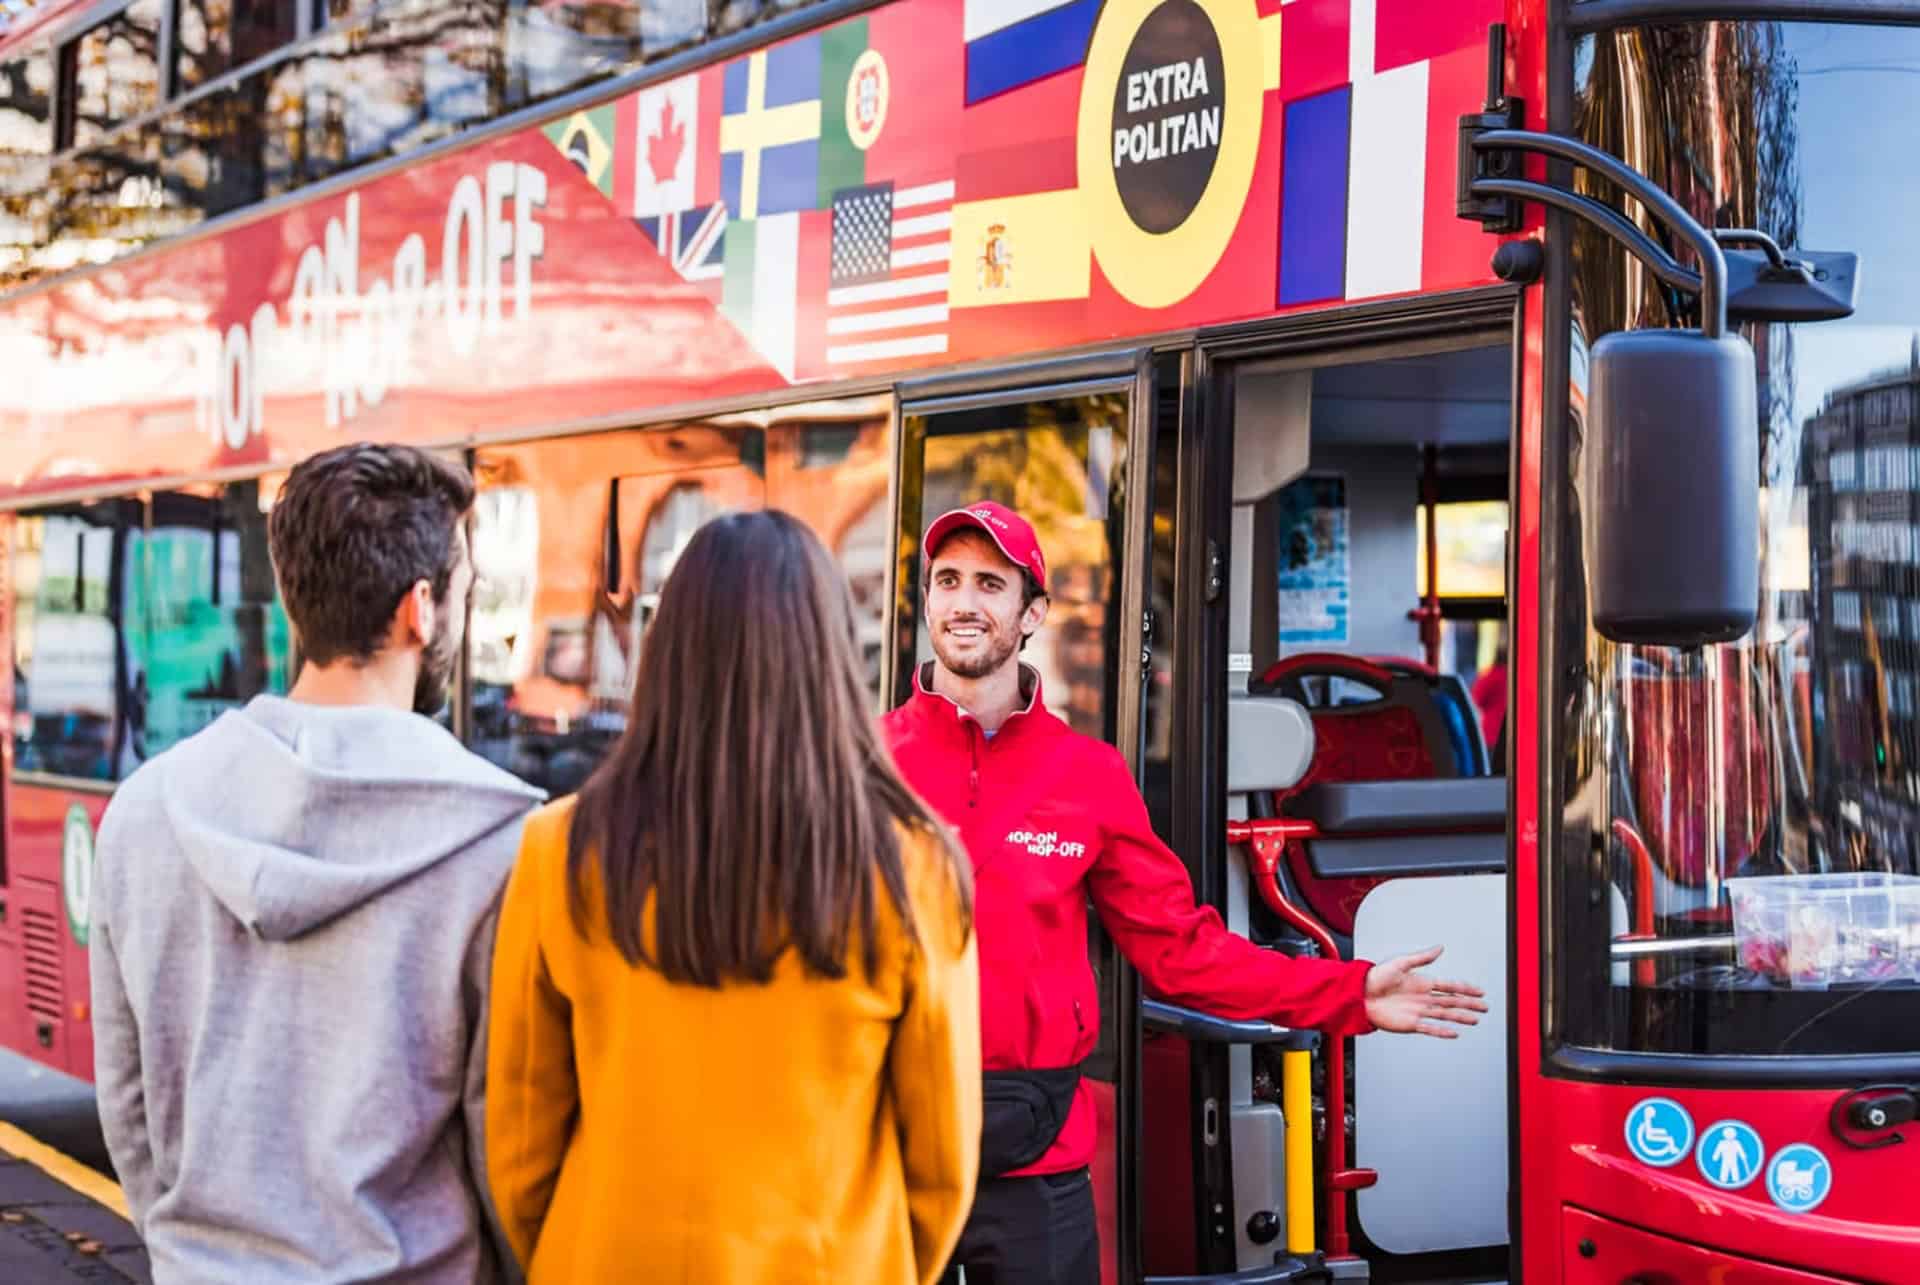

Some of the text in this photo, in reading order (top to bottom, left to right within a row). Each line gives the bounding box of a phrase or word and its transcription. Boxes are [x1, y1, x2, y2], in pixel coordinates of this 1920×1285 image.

[1127, 57, 1209, 112] EXTRA
[1114, 106, 1219, 168] POLITAN
[197, 191, 360, 450] OPON
[1027, 841, 1085, 858] HOP-OFF
